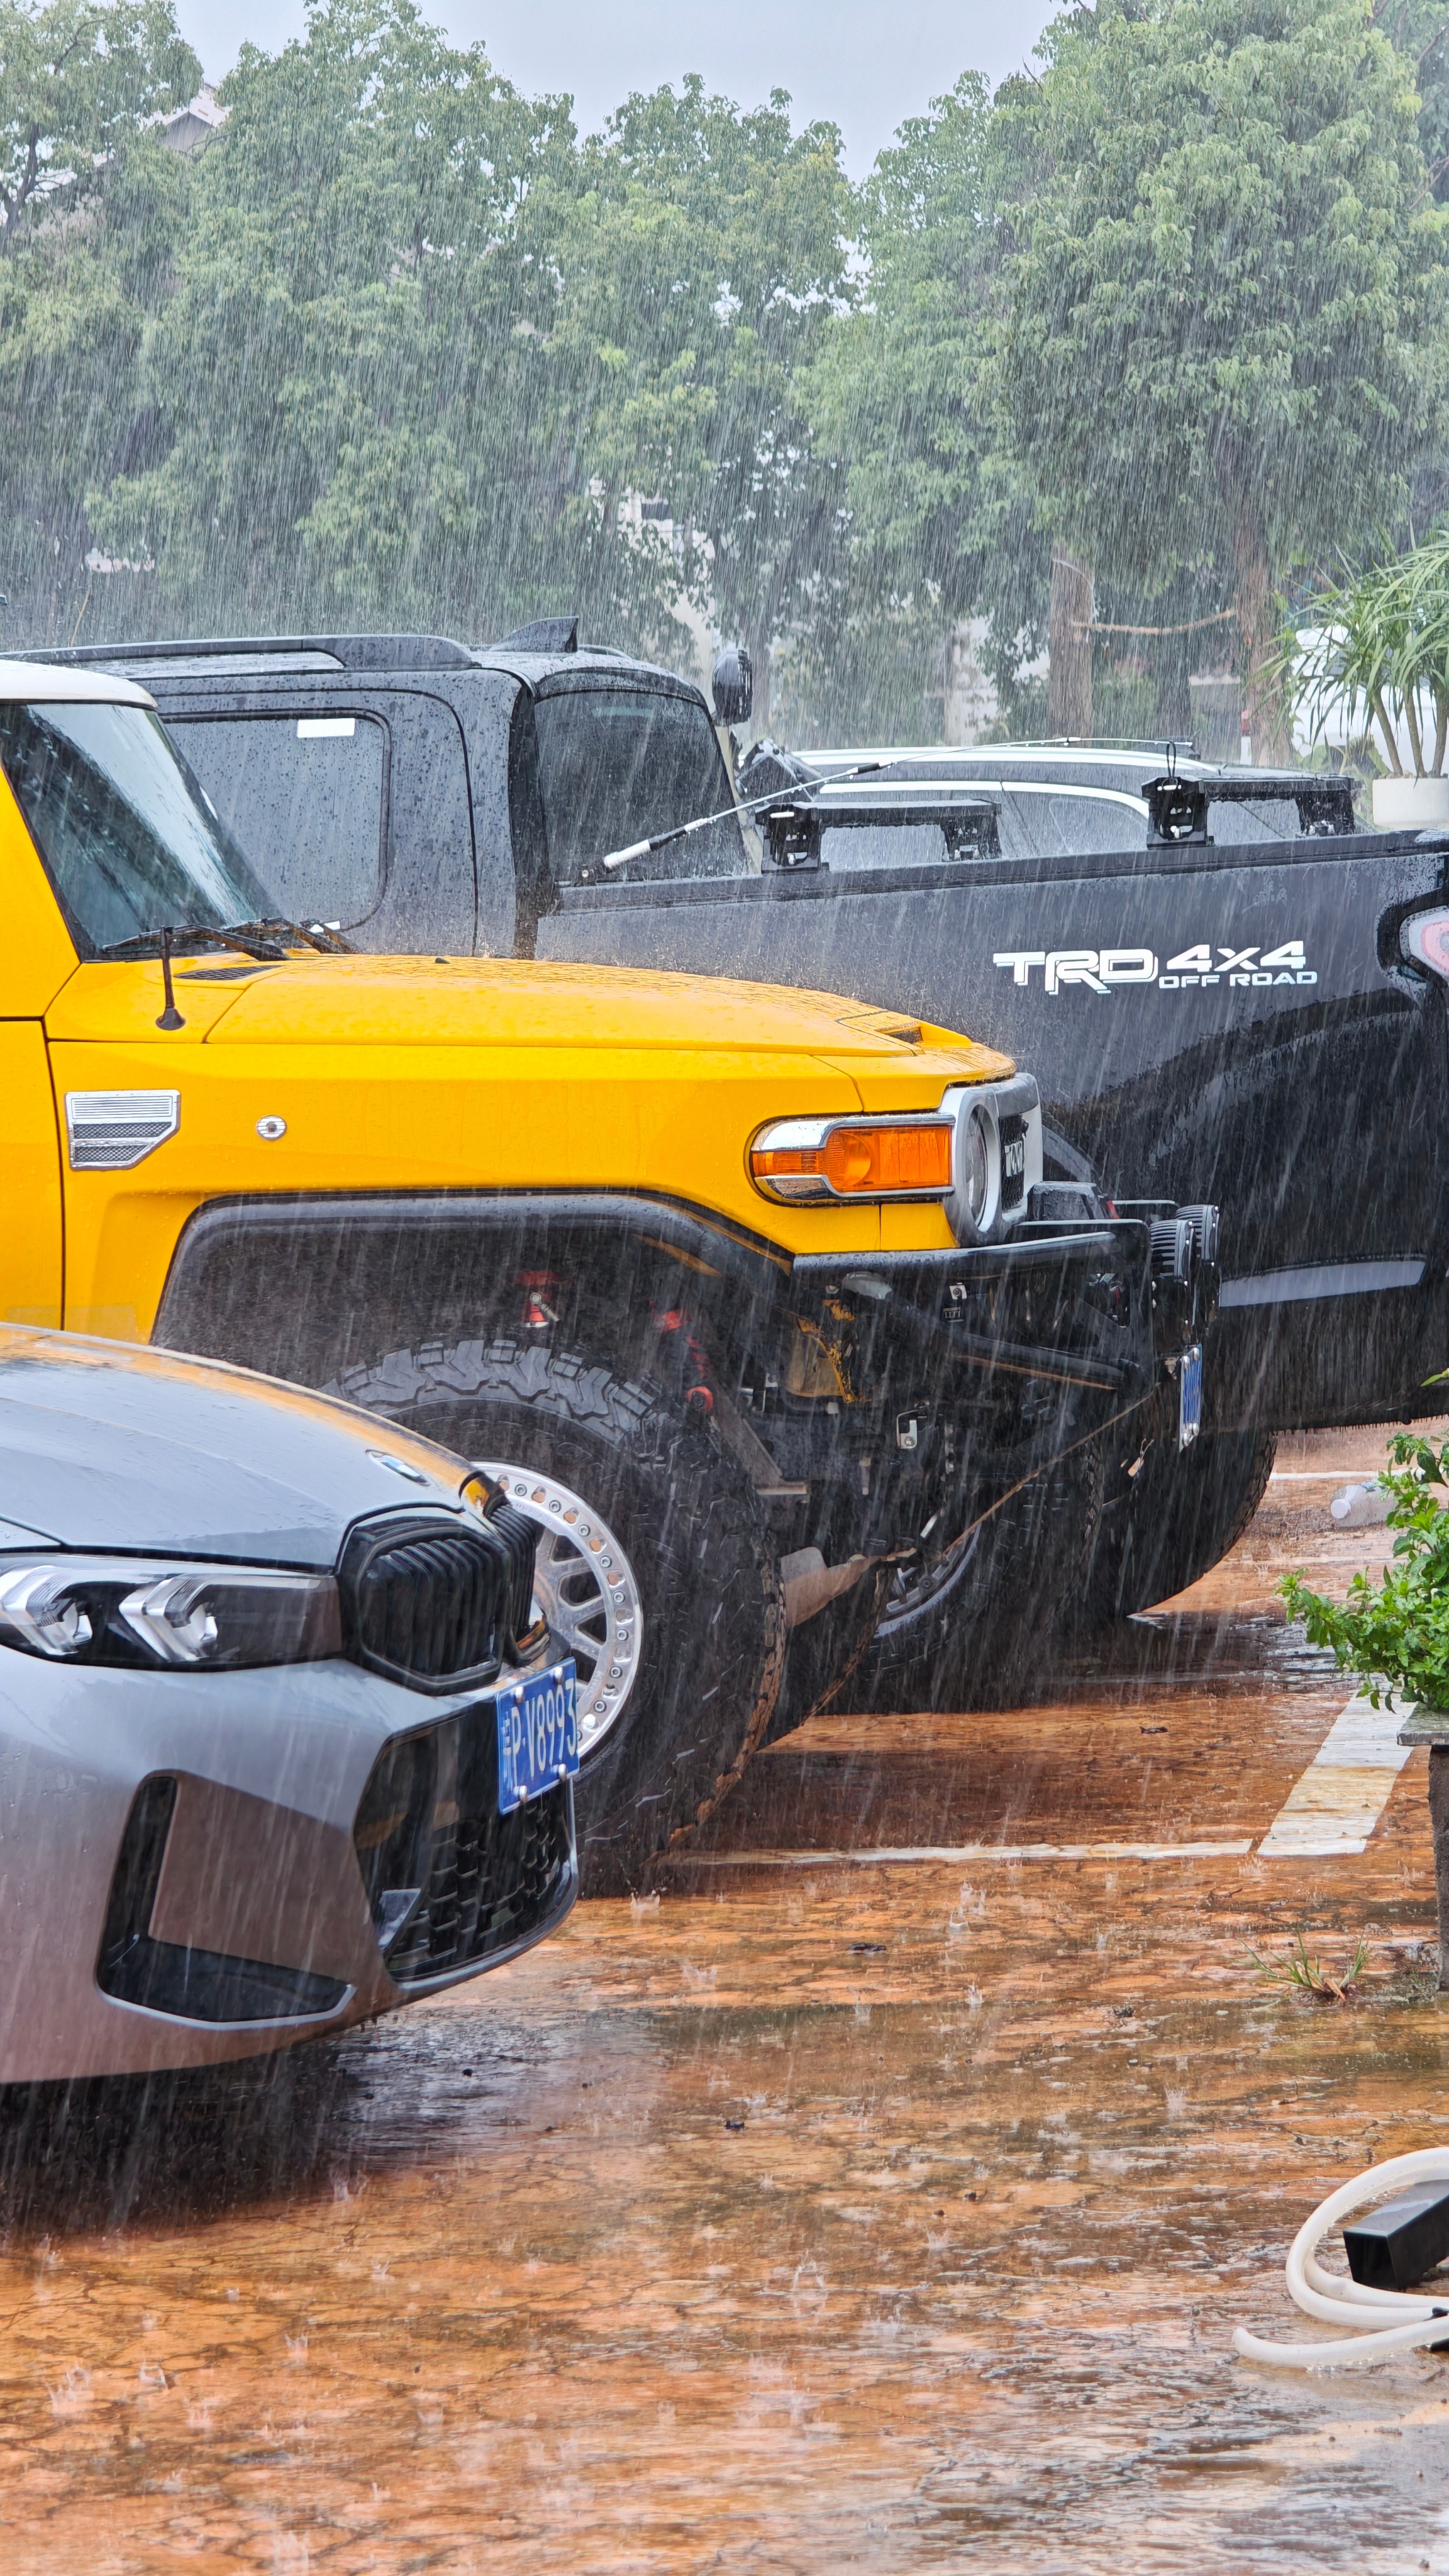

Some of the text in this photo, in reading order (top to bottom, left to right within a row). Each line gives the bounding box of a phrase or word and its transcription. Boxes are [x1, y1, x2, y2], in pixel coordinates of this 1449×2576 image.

[993, 948, 1158, 996] TRD
[1158, 971, 1318, 989] OFF ROAD
